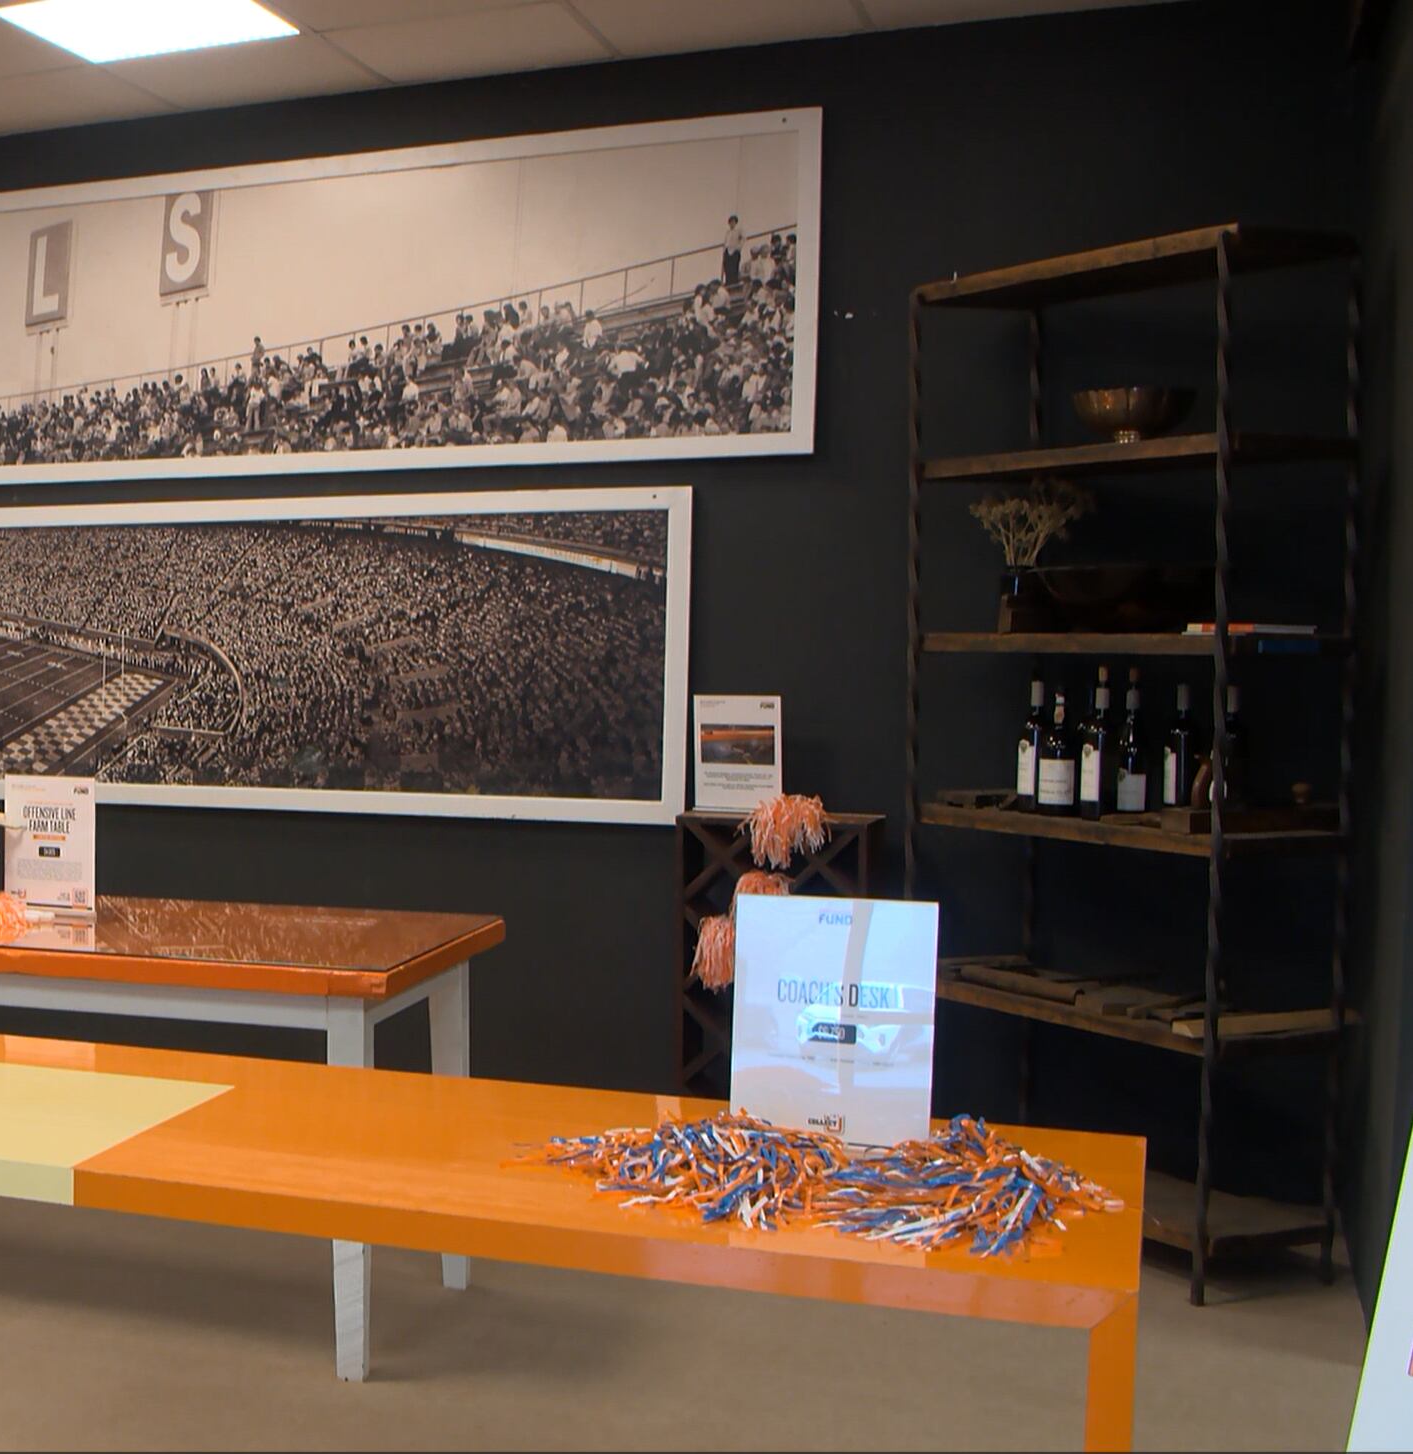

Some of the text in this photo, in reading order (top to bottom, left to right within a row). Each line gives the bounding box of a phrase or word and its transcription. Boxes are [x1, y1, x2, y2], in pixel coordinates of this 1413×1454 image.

[22, 805, 76, 821] OFFENSIVE LINE
[28, 819, 71, 834] FARM TABLE
[818, 913, 853, 926] FUND
[777, 977, 890, 1010] COACH'S DESK
